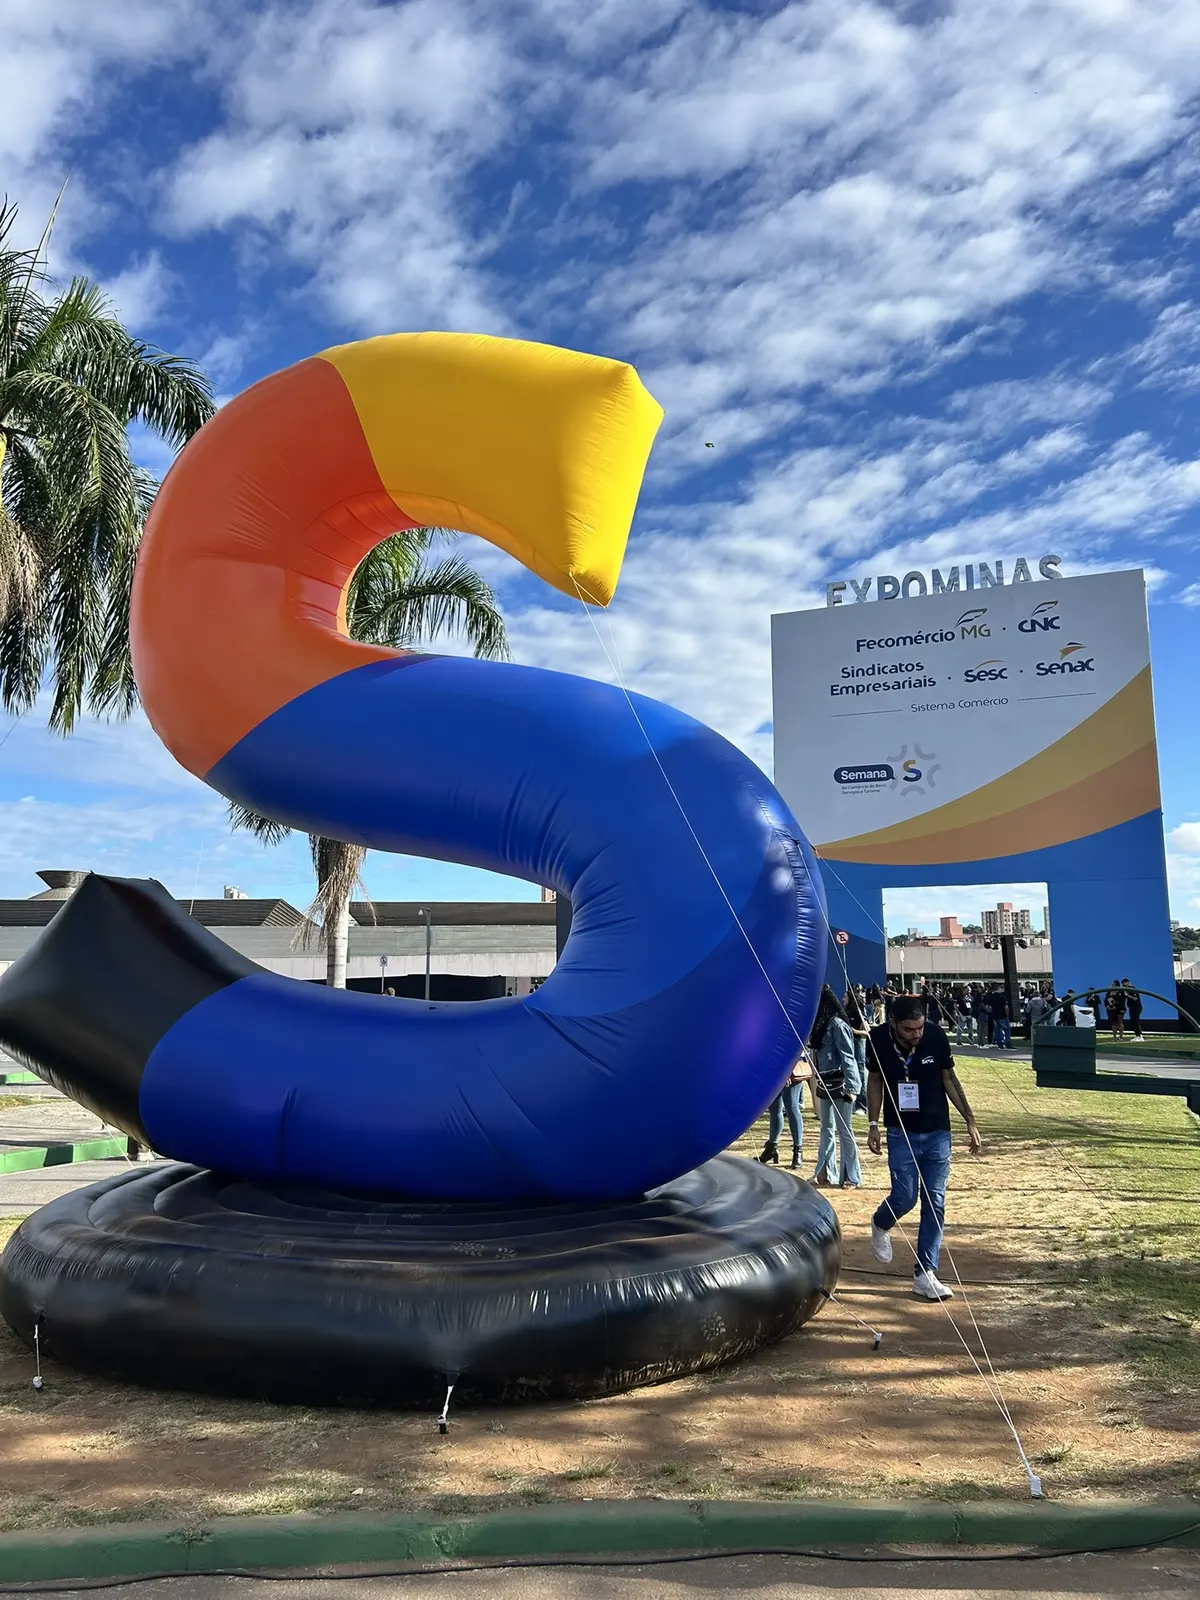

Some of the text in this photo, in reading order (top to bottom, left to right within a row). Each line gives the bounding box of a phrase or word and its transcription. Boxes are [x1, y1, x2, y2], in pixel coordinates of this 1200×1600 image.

[826, 554, 1063, 607] EXPOMINAS
[1018, 615, 1061, 633] CNC
[856, 623, 991, 653] Fecomércio MG
[840, 660, 925, 679] Sindicatos
[964, 666, 1009, 683] Sesc
[1035, 657, 1095, 676] Senac
[830, 676, 937, 697] Empresariais
[911, 696, 1009, 713] Sistema Comércio
[841, 770, 887, 780] Semana
[903, 759, 922, 782] S
